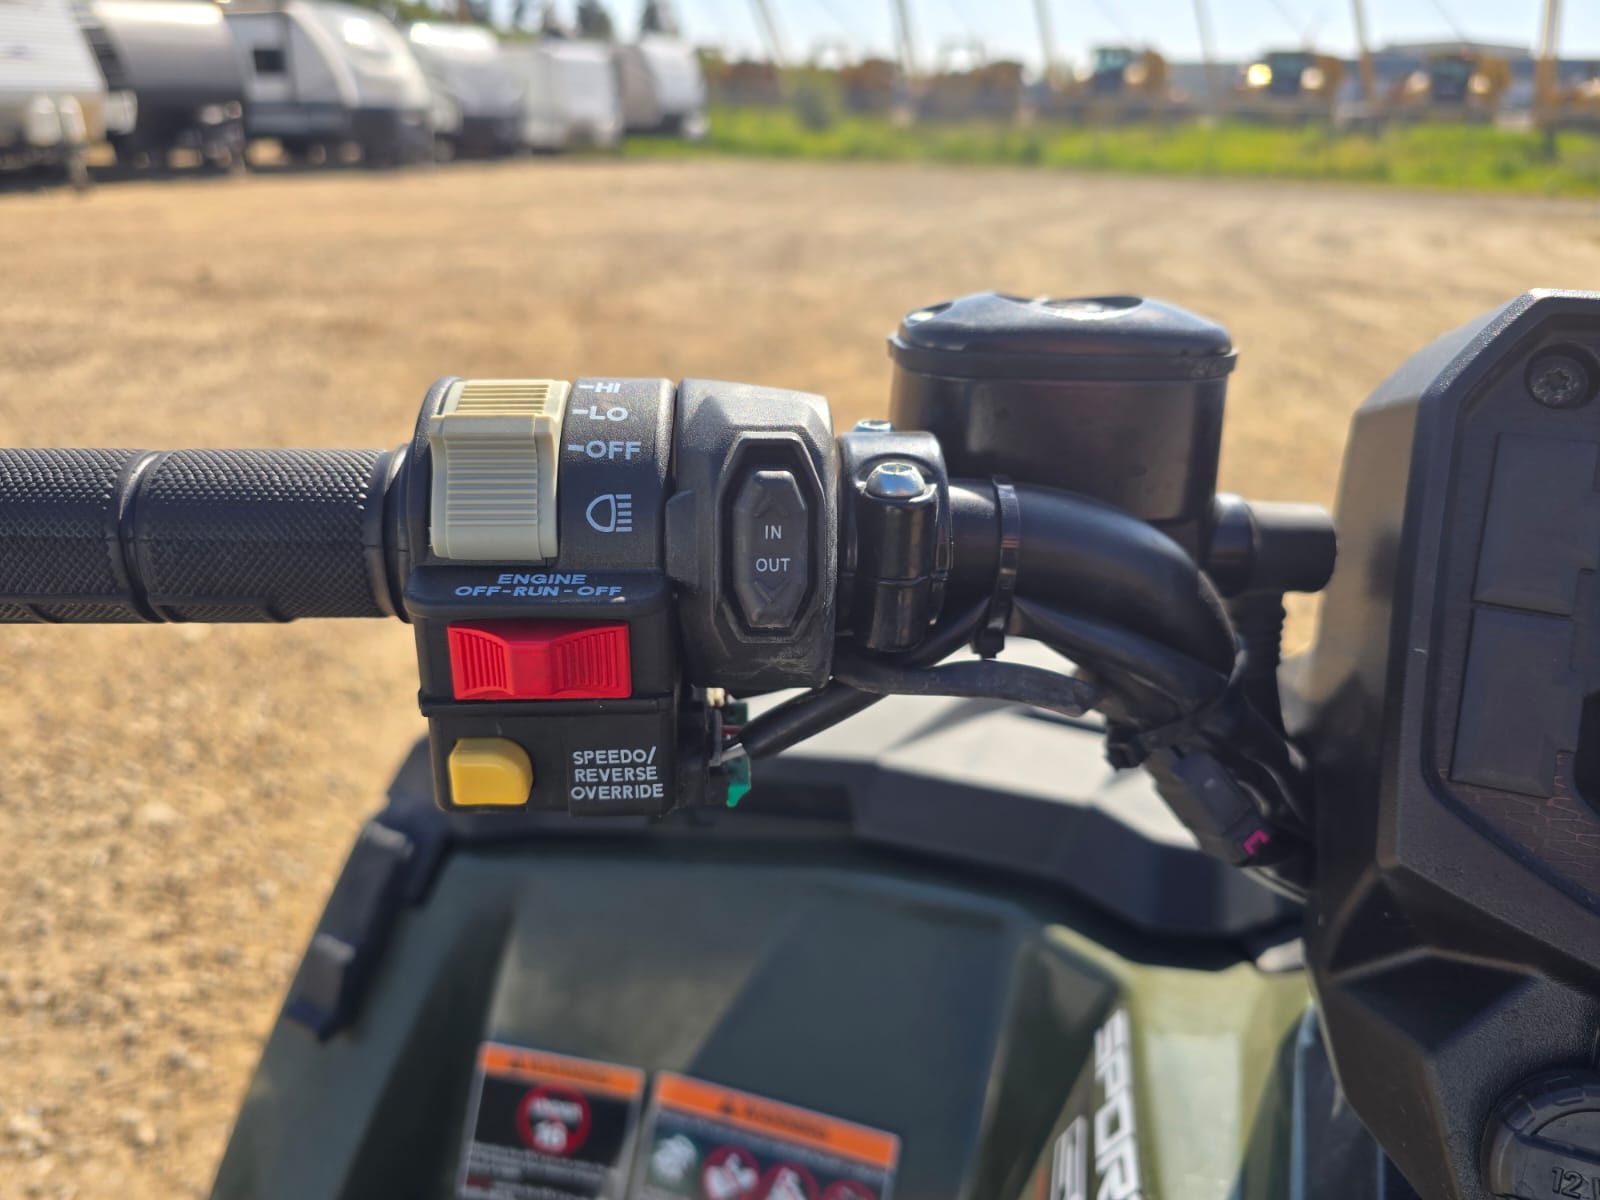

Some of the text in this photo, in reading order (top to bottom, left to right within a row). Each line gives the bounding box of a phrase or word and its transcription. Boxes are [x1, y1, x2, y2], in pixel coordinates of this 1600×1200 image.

[764, 524, 782, 540] IN
[755, 557, 791, 572] OUT
[497, 573, 587, 585] ENGINE
[572, 745, 657, 765] SPEEDO/
[574, 766, 658, 782] REVERSE
[570, 783, 664, 800] OVERRIDE
[1094, 1007, 1143, 1200] SPOR
[1551, 1166, 1583, 1199] 12
